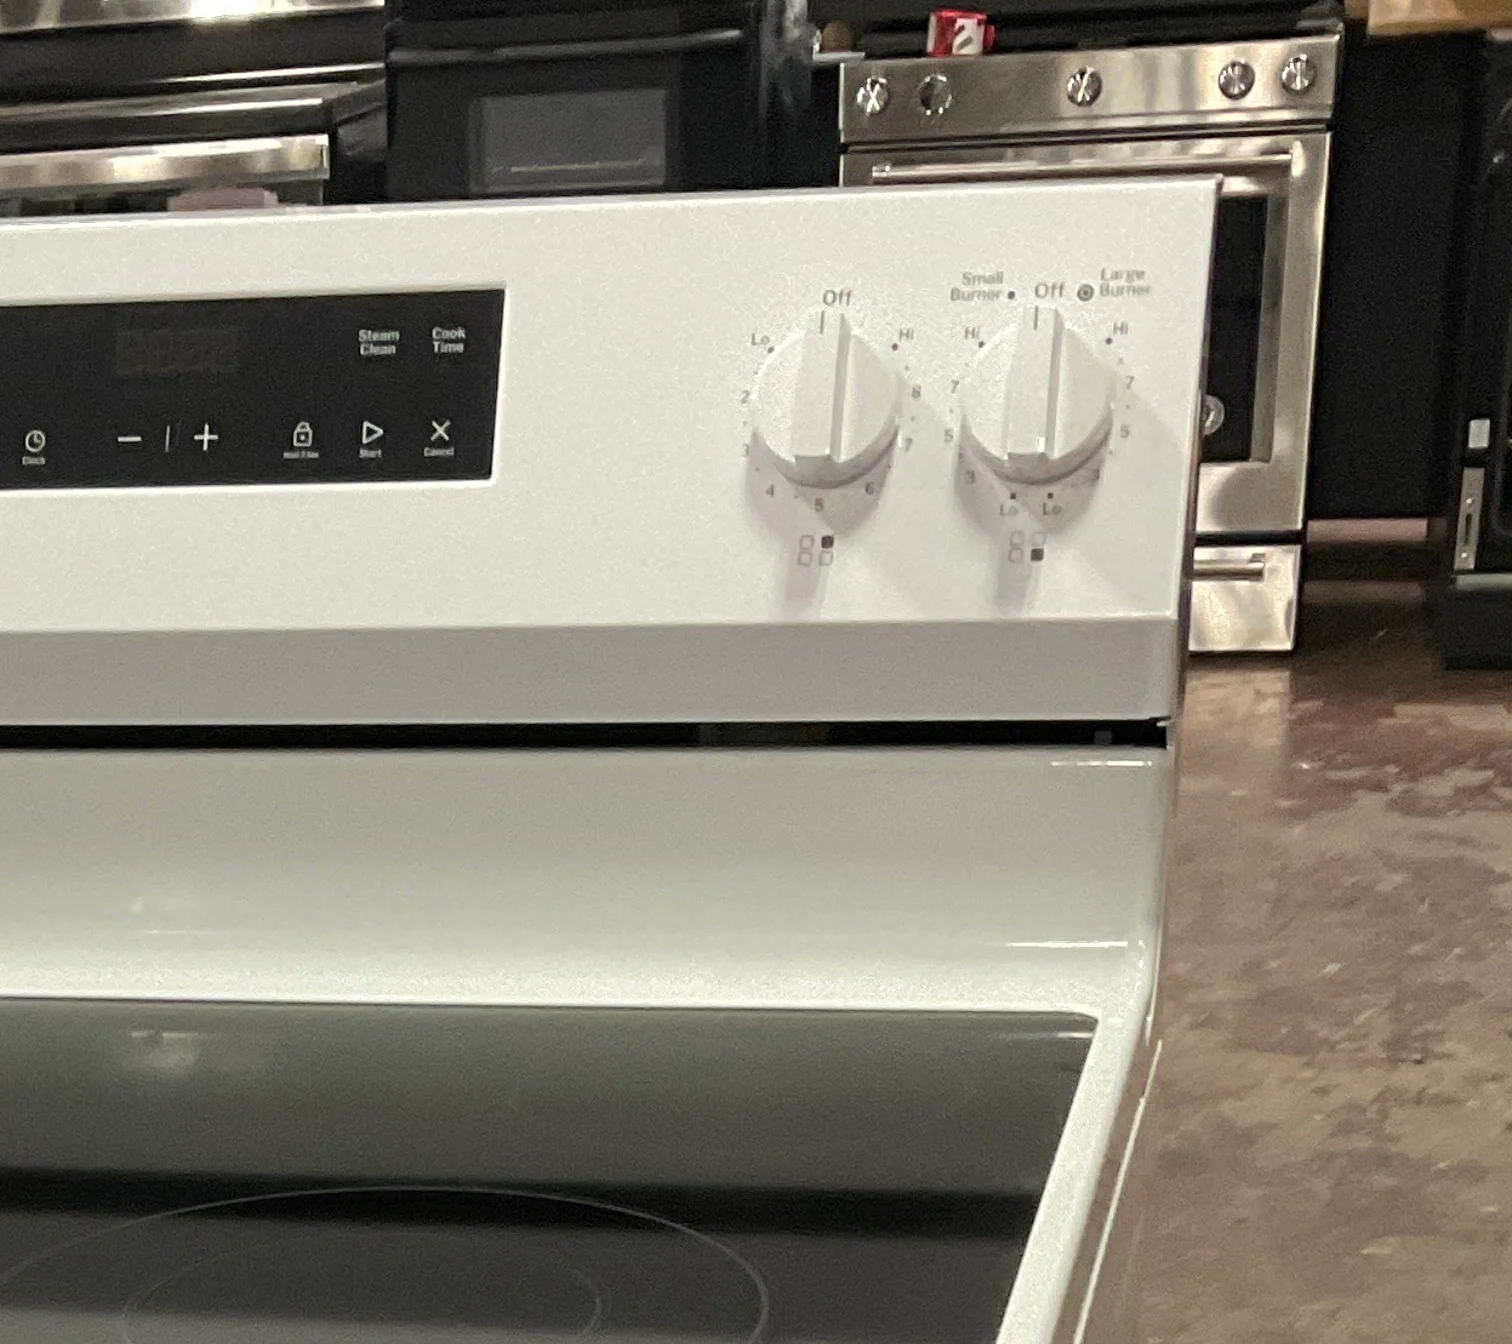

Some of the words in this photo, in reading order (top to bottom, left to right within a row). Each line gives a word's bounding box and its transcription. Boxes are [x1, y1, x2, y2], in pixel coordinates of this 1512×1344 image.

[961, 270, 1005, 286] Small
[1100, 267, 1146, 283] Large
[822, 288, 853, 306] Off
[950, 286, 1002, 301] Burner
[1034, 281, 1066, 299] Off
[1099, 282, 1152, 297] Burner
[357, 328, 400, 342] Steam
[431, 325, 467, 340] Cook
[898, 327, 915, 342] Hi
[964, 326, 981, 340] Hi
[1113, 320, 1129, 335] Hi
[751, 332, 771, 346] Lo
[359, 342, 396, 356] Clean
[432, 341, 464, 354] Time
[1042, 502, 1063, 516] Lo
